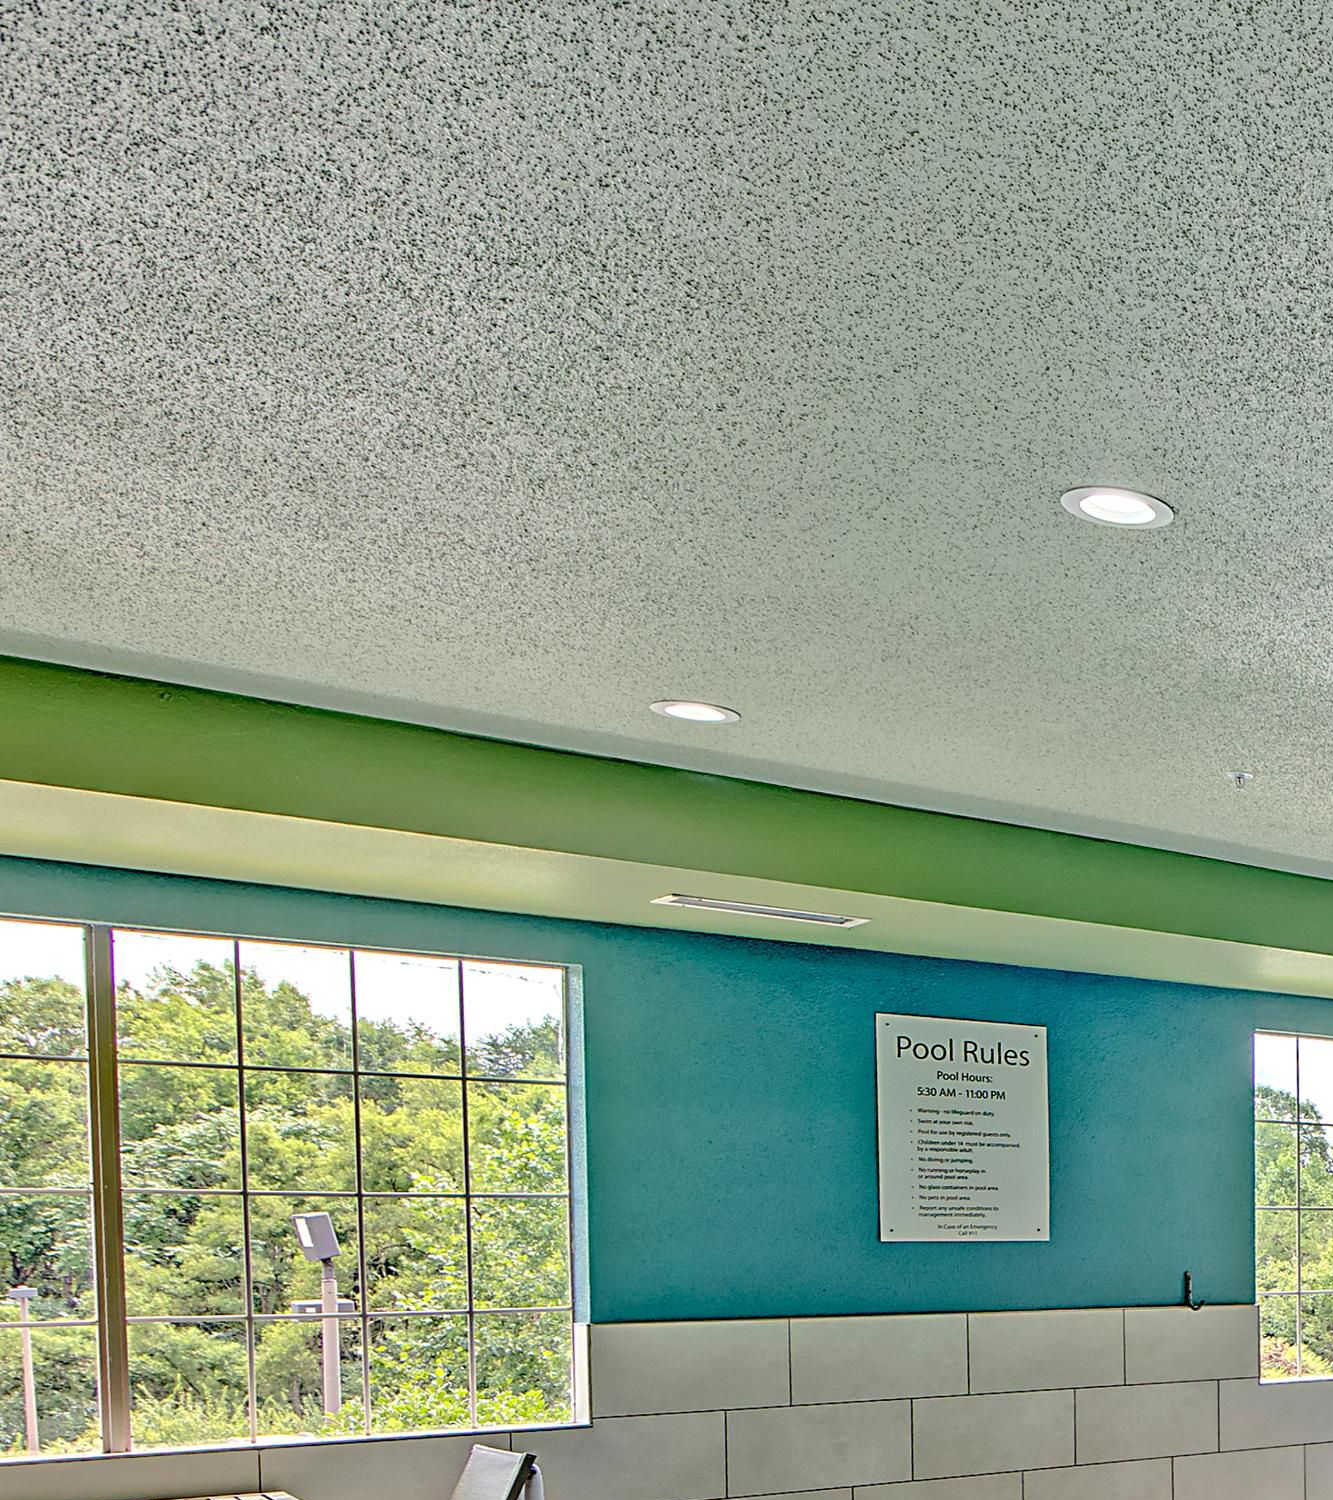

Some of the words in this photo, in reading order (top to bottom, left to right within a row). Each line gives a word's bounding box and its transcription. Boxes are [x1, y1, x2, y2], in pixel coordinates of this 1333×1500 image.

[896, 1036, 954, 1062] Pool
[963, 1040, 1031, 1067] Rules
[936, 1071, 959, 1081] Pool
[961, 1073, 994, 1084] Hours:
[917, 1086, 937, 1097] 5:30
[939, 1087, 957, 1098] AM
[966, 1088, 990, 1100] 11:00
[991, 1090, 1007, 1101] PM
